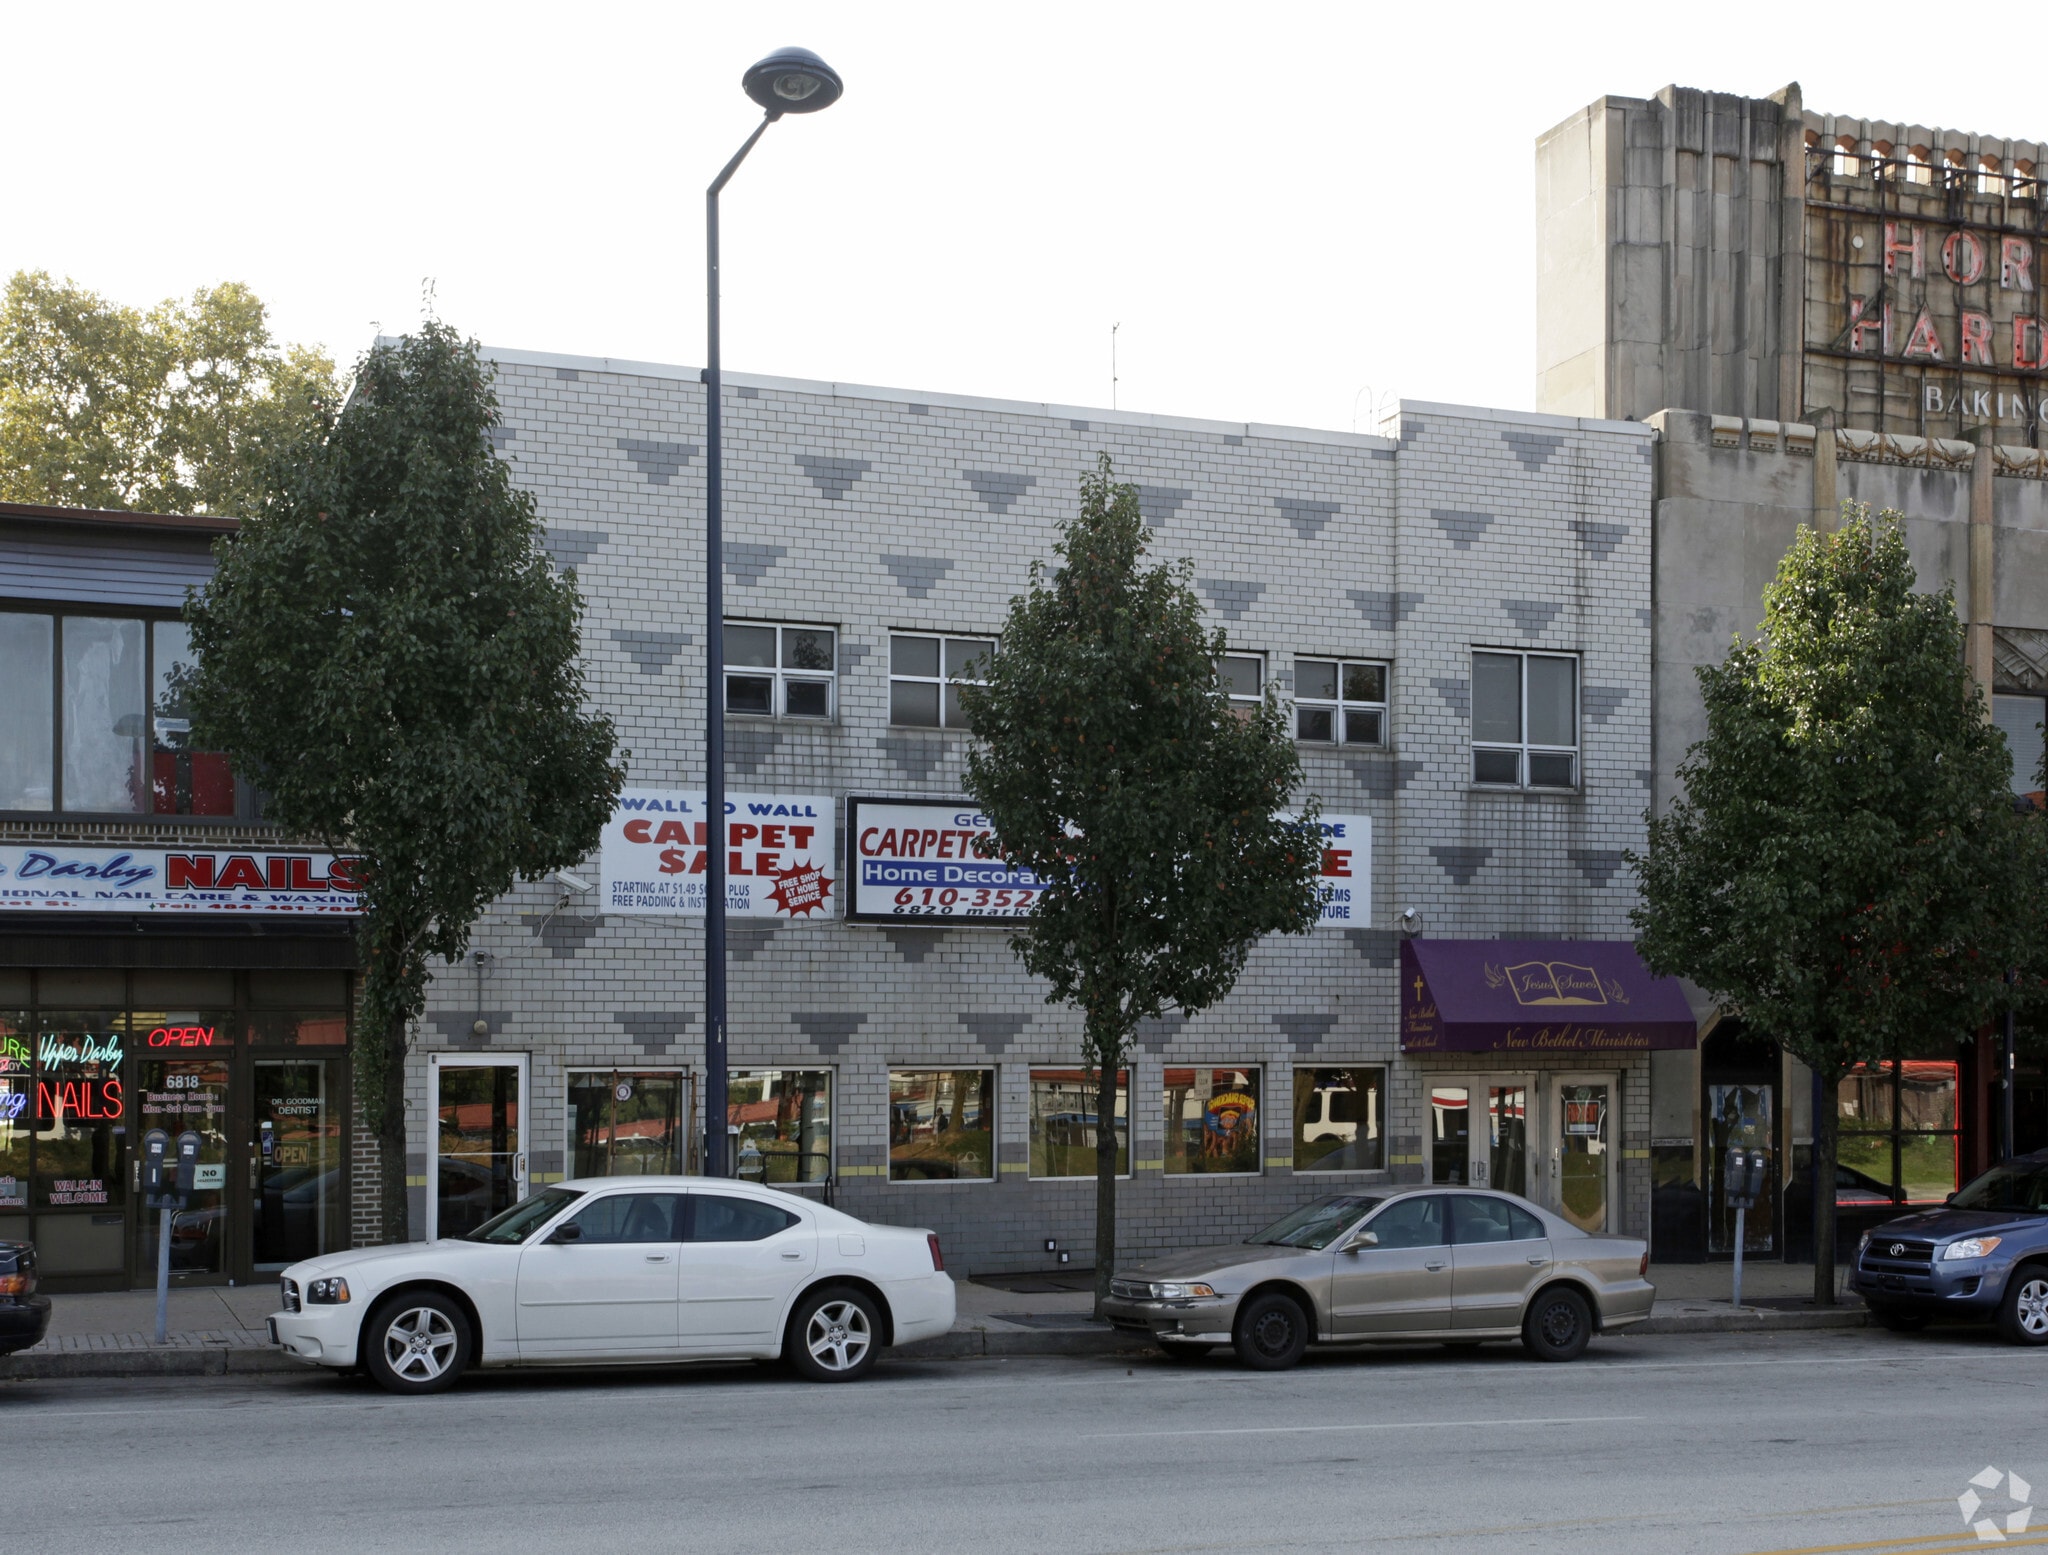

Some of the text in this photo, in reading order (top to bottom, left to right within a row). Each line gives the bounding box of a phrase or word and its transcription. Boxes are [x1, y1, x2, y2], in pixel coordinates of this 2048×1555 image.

[1884, 221, 2034, 292] HOR
[621, 797, 817, 817] WALL O WALL
[17, 851, 370, 893] Darby NAILS
[778, 871, 821, 890] FREE SHOP
[865, 863, 937, 882] Home
[612, 881, 656, 894] STARTING
[658, 883, 670, 894] AT
[673, 883, 697, 895] $1.49
[729, 885, 750, 896] PLUS
[785, 880, 820, 899] AT HOME
[95, 891, 158, 900] NAIL
[165, 892, 232, 902] CARE
[241, 894, 261, 902] &
[270, 894, 362, 904] WAXIN
[612, 895, 750, 910] FREE PADDING & INSTATION
[788, 890, 822, 907] SERVICE
[893, 905, 1031, 917] 6820 mark
[148, 1026, 214, 1047] OPEN
[1493, 1023, 1649, 1049] New Bethel Ministries
[39, 1034, 78, 1071] Upper
[79, 1034, 123, 1072] Darby
[166, 1075, 199, 1089] 6818
[37, 1081, 123, 1119] NAILS
[147, 1092, 185, 1102] Business
[286, 1097, 325, 1105] GOODMAN
[278, 1106, 317, 1115] DENTIST
[274, 1146, 308, 1163] OPEN
[54, 1179, 103, 1192] WALK-IN
[49, 1191, 108, 1205] WELCOME
